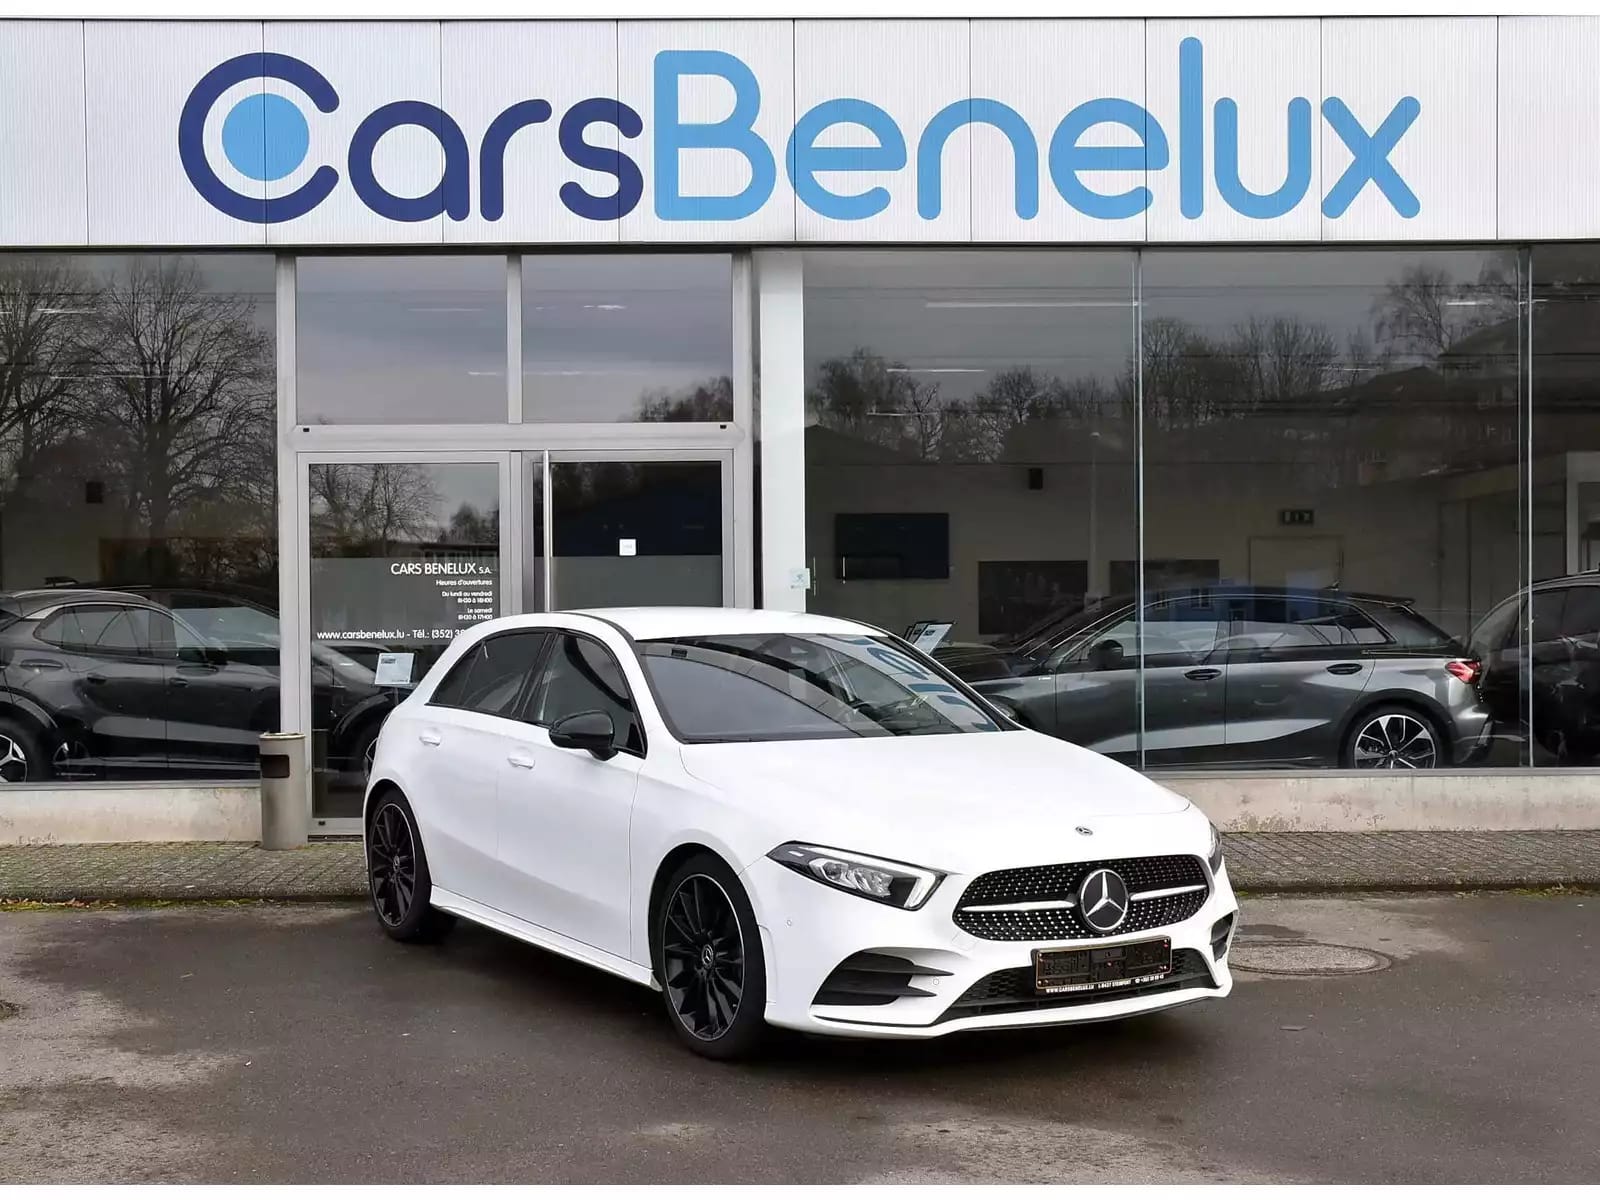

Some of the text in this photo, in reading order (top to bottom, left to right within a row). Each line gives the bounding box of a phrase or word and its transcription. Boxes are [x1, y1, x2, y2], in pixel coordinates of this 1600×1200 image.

[390, 563, 422, 575] CARS
[424, 563, 477, 575] BENELUX
[316, 629, 405, 640] www.carsbenelux.lu
[431, 629, 454, 640] (352)
